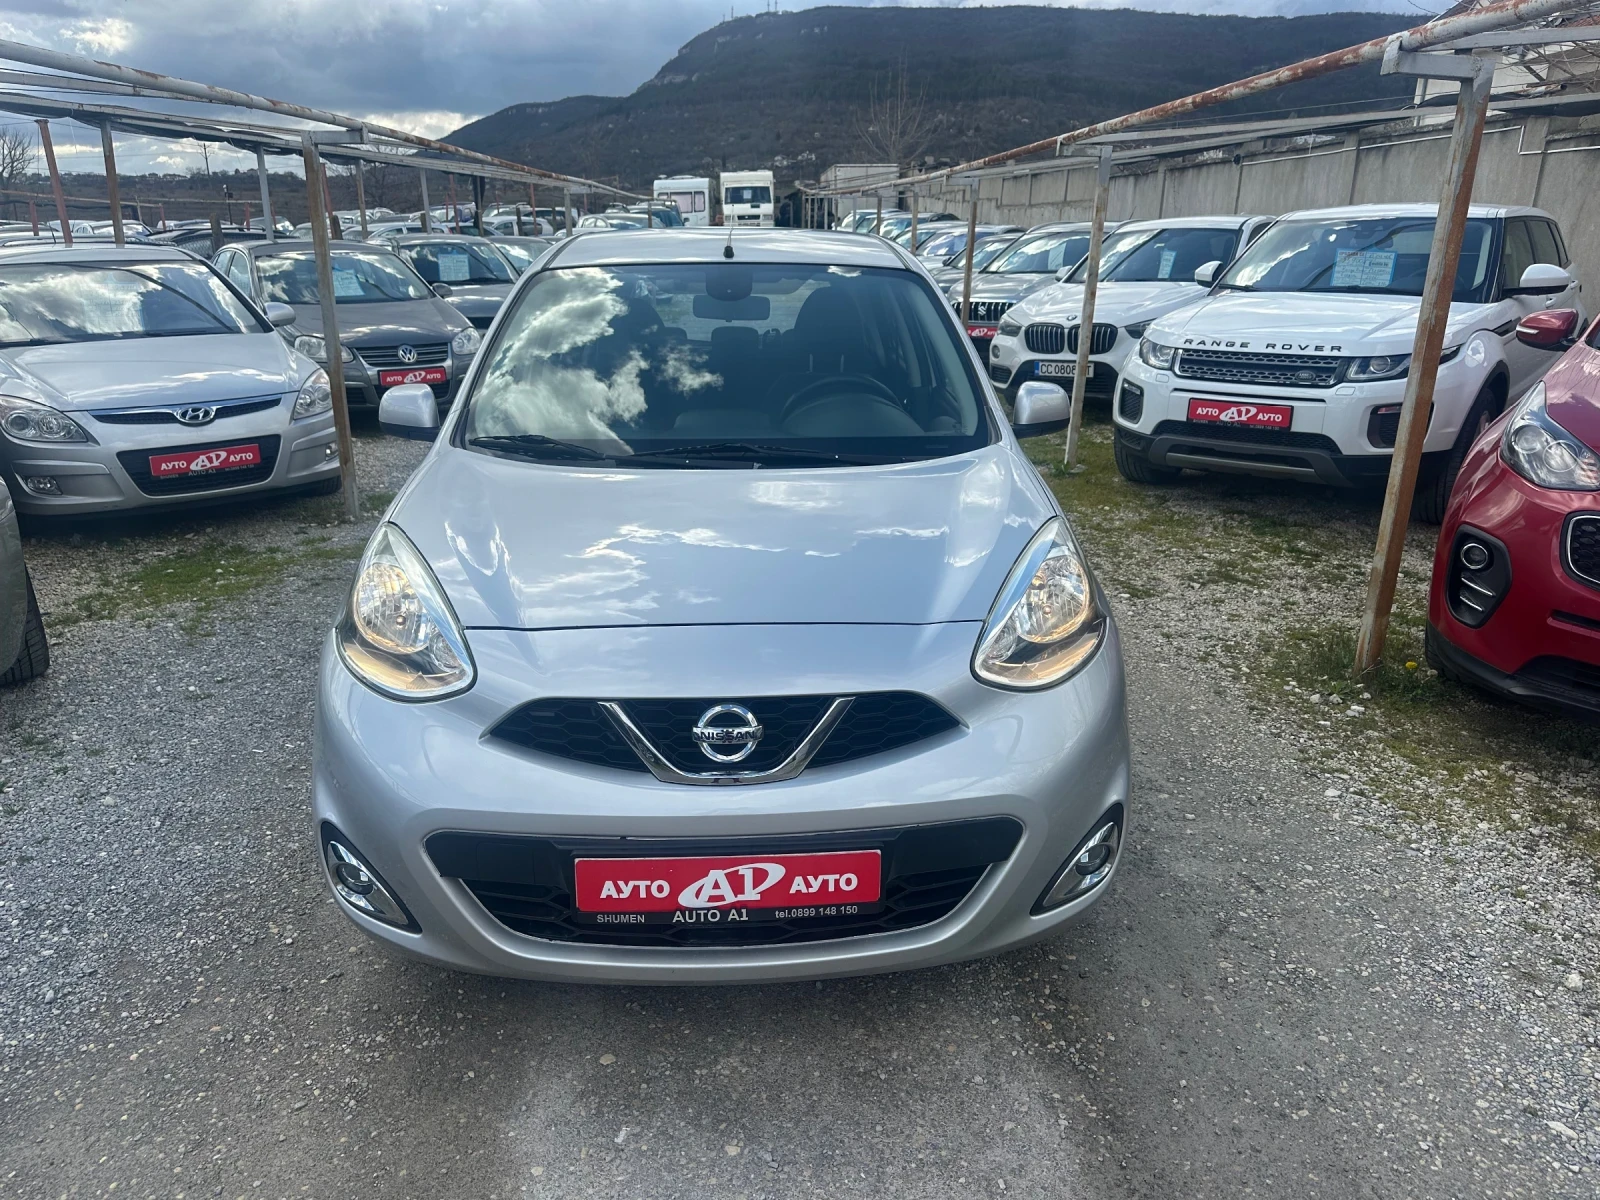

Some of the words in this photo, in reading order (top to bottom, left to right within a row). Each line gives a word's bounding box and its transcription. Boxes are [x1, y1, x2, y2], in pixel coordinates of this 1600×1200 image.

[1183, 338, 1251, 348] RANGE
[1265, 343, 1343, 353] ROVER
[1040, 363, 1053, 375] CC
[1196, 407, 1219, 416] АУТО
[1257, 413, 1283, 422] АУТО
[160, 460, 187, 471] АУТО
[229, 452, 253, 463] АУТО
[700, 730, 755, 741] NISSAN
[600, 880, 671, 899] АУТО
[789, 873, 859, 894] АУТО
[596, 914, 645, 924] SHUMEN
[672, 909, 721, 923] AUTO
[727, 908, 749, 922] A1
[775, 908, 816, 919] tel.0899
[818, 906, 837, 917] 148
[840, 905, 858, 916] 150
